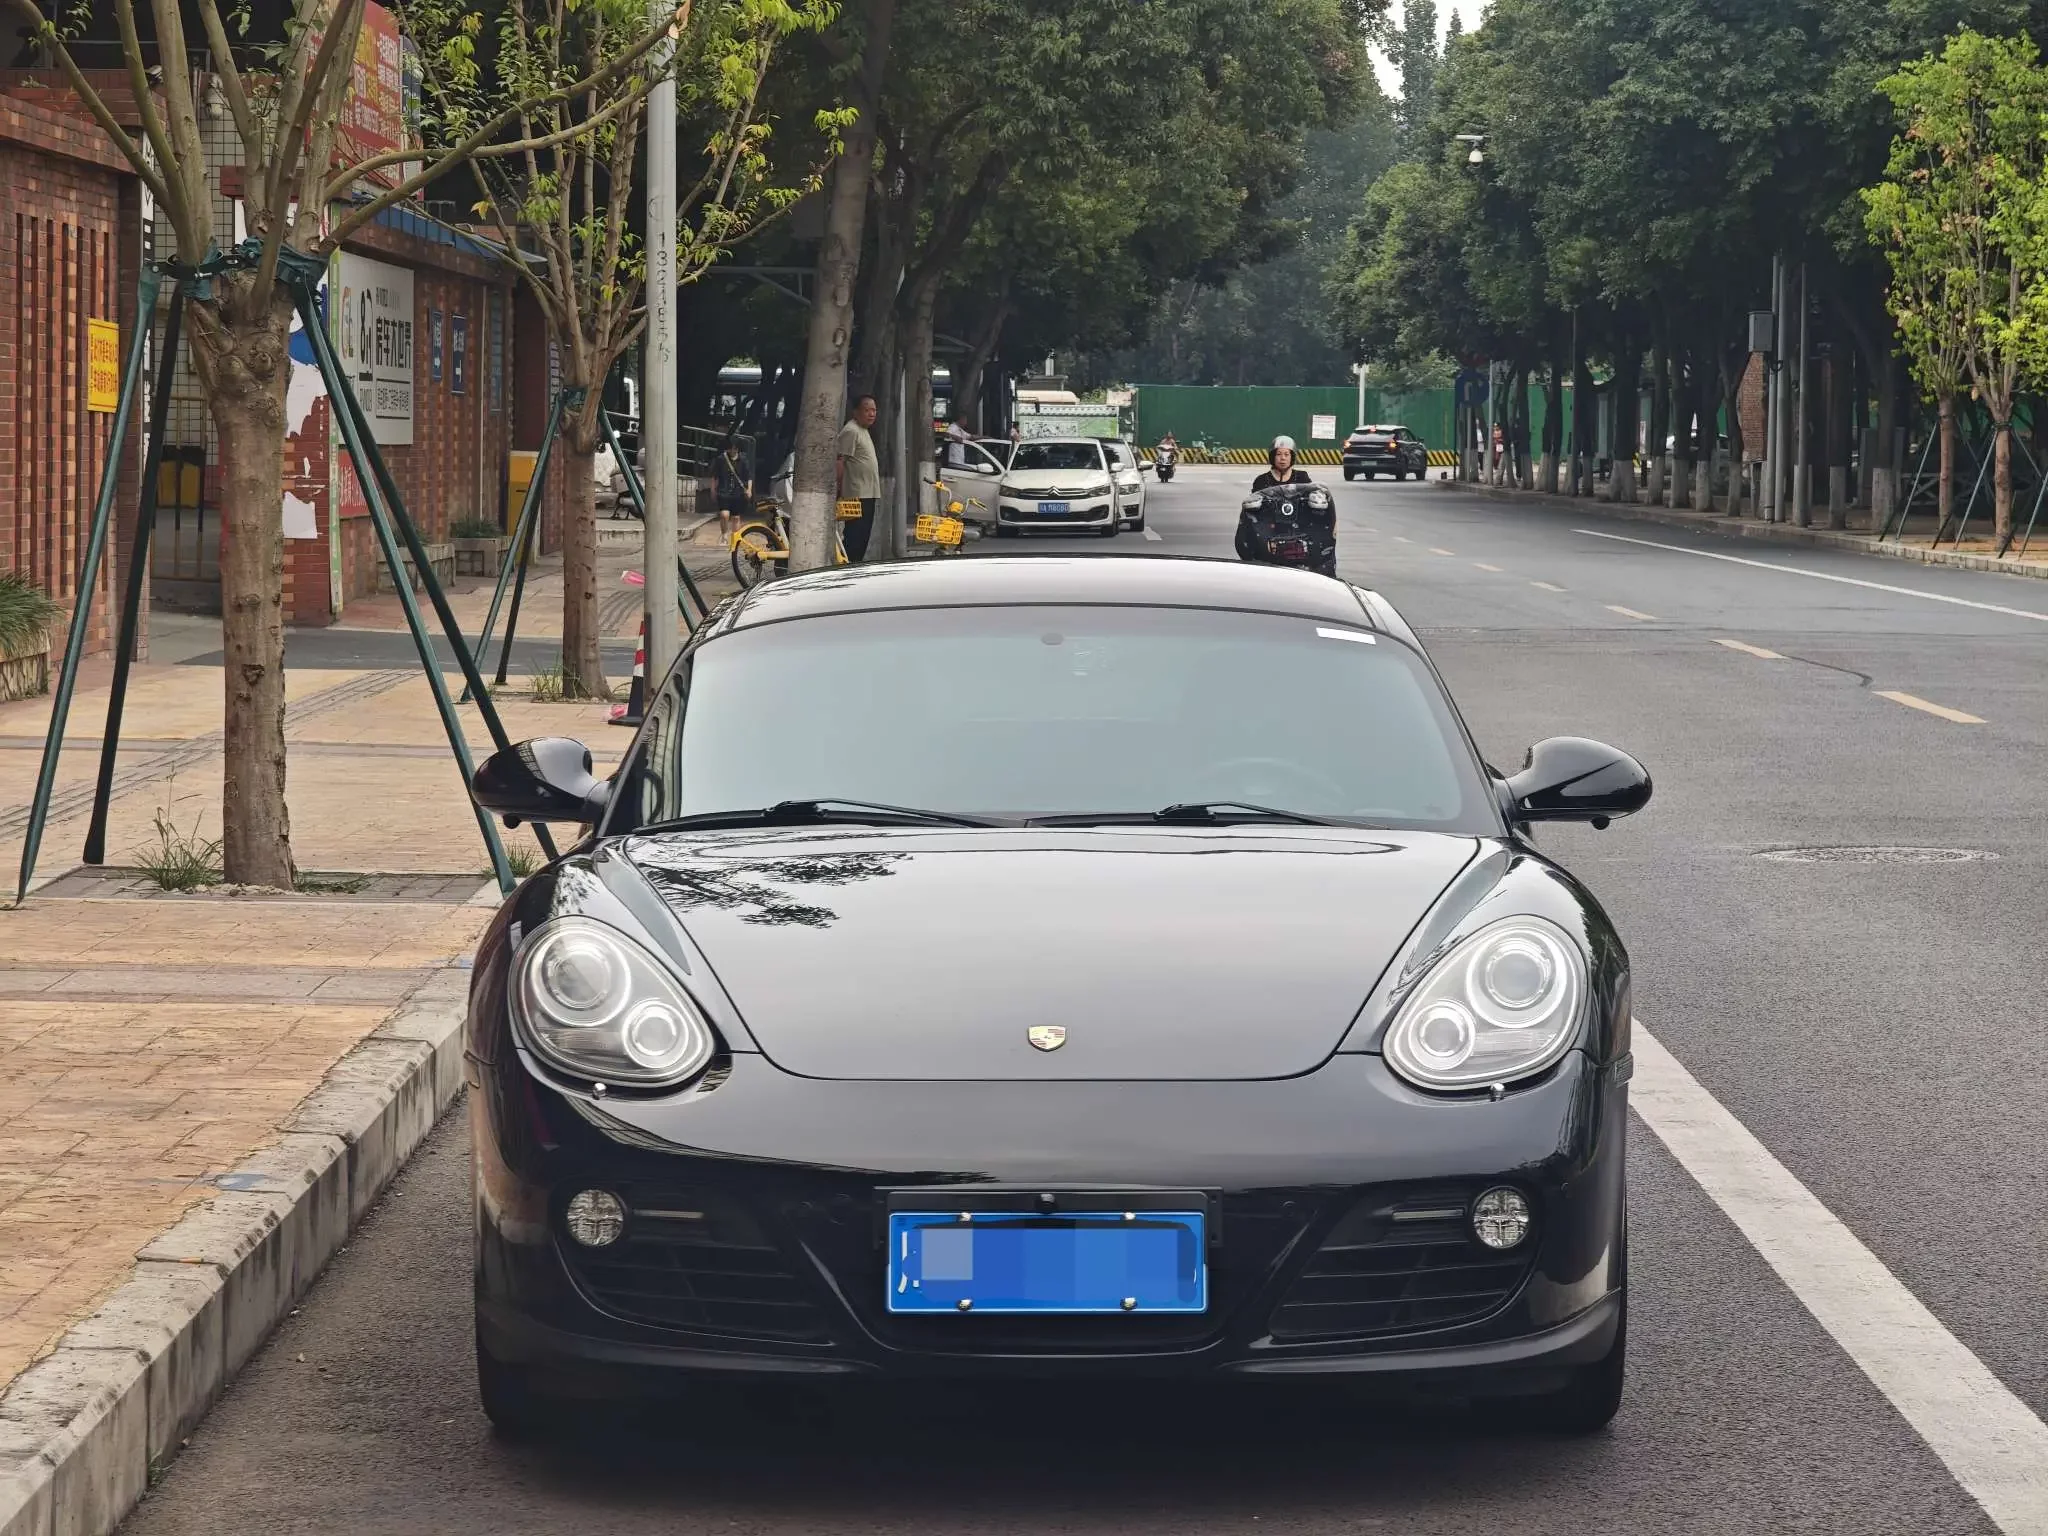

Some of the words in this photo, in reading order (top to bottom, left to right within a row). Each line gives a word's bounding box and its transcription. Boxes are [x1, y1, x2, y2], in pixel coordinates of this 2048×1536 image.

[375, 315, 411, 369] 房车大世界
